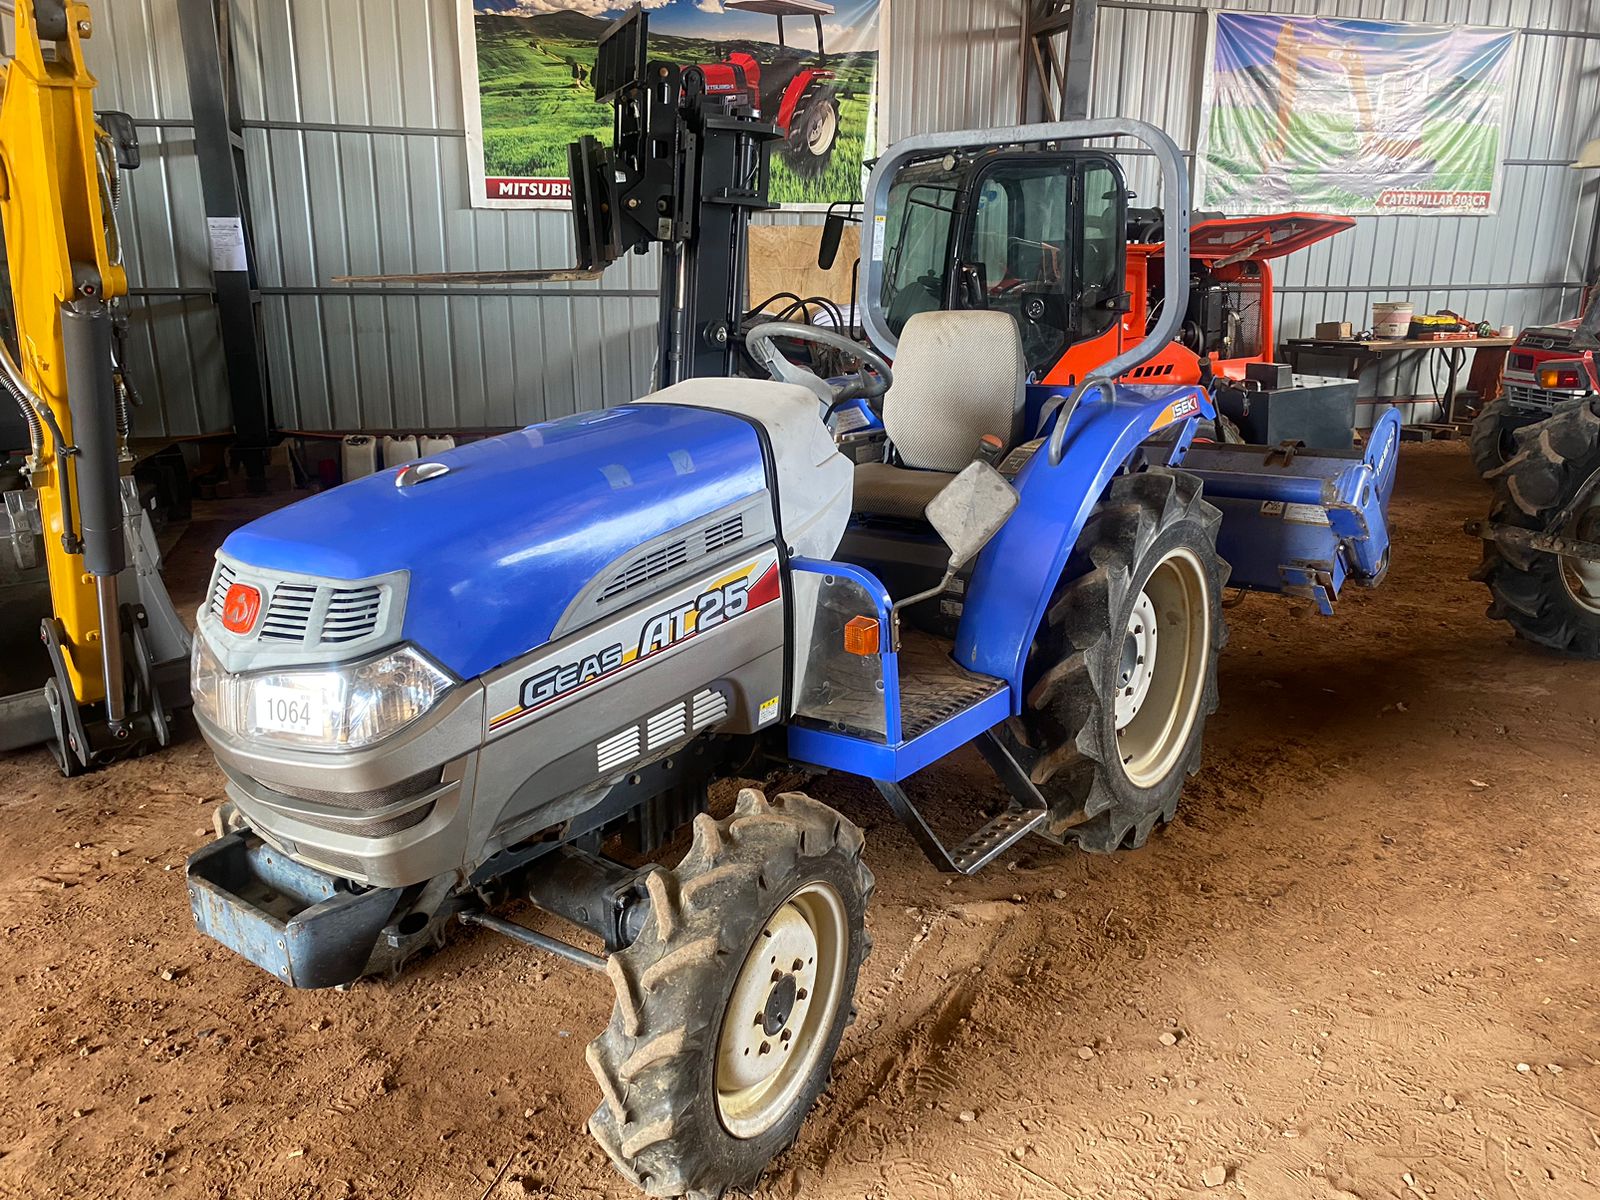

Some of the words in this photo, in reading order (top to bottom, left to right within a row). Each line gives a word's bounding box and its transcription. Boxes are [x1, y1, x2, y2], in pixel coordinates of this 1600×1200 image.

[1382, 194, 1453, 206] CATERPILLAR
[1454, 195, 1487, 206] 303CR
[1171, 397, 1198, 417] ISEKI
[267, 698, 311, 725] 1064
